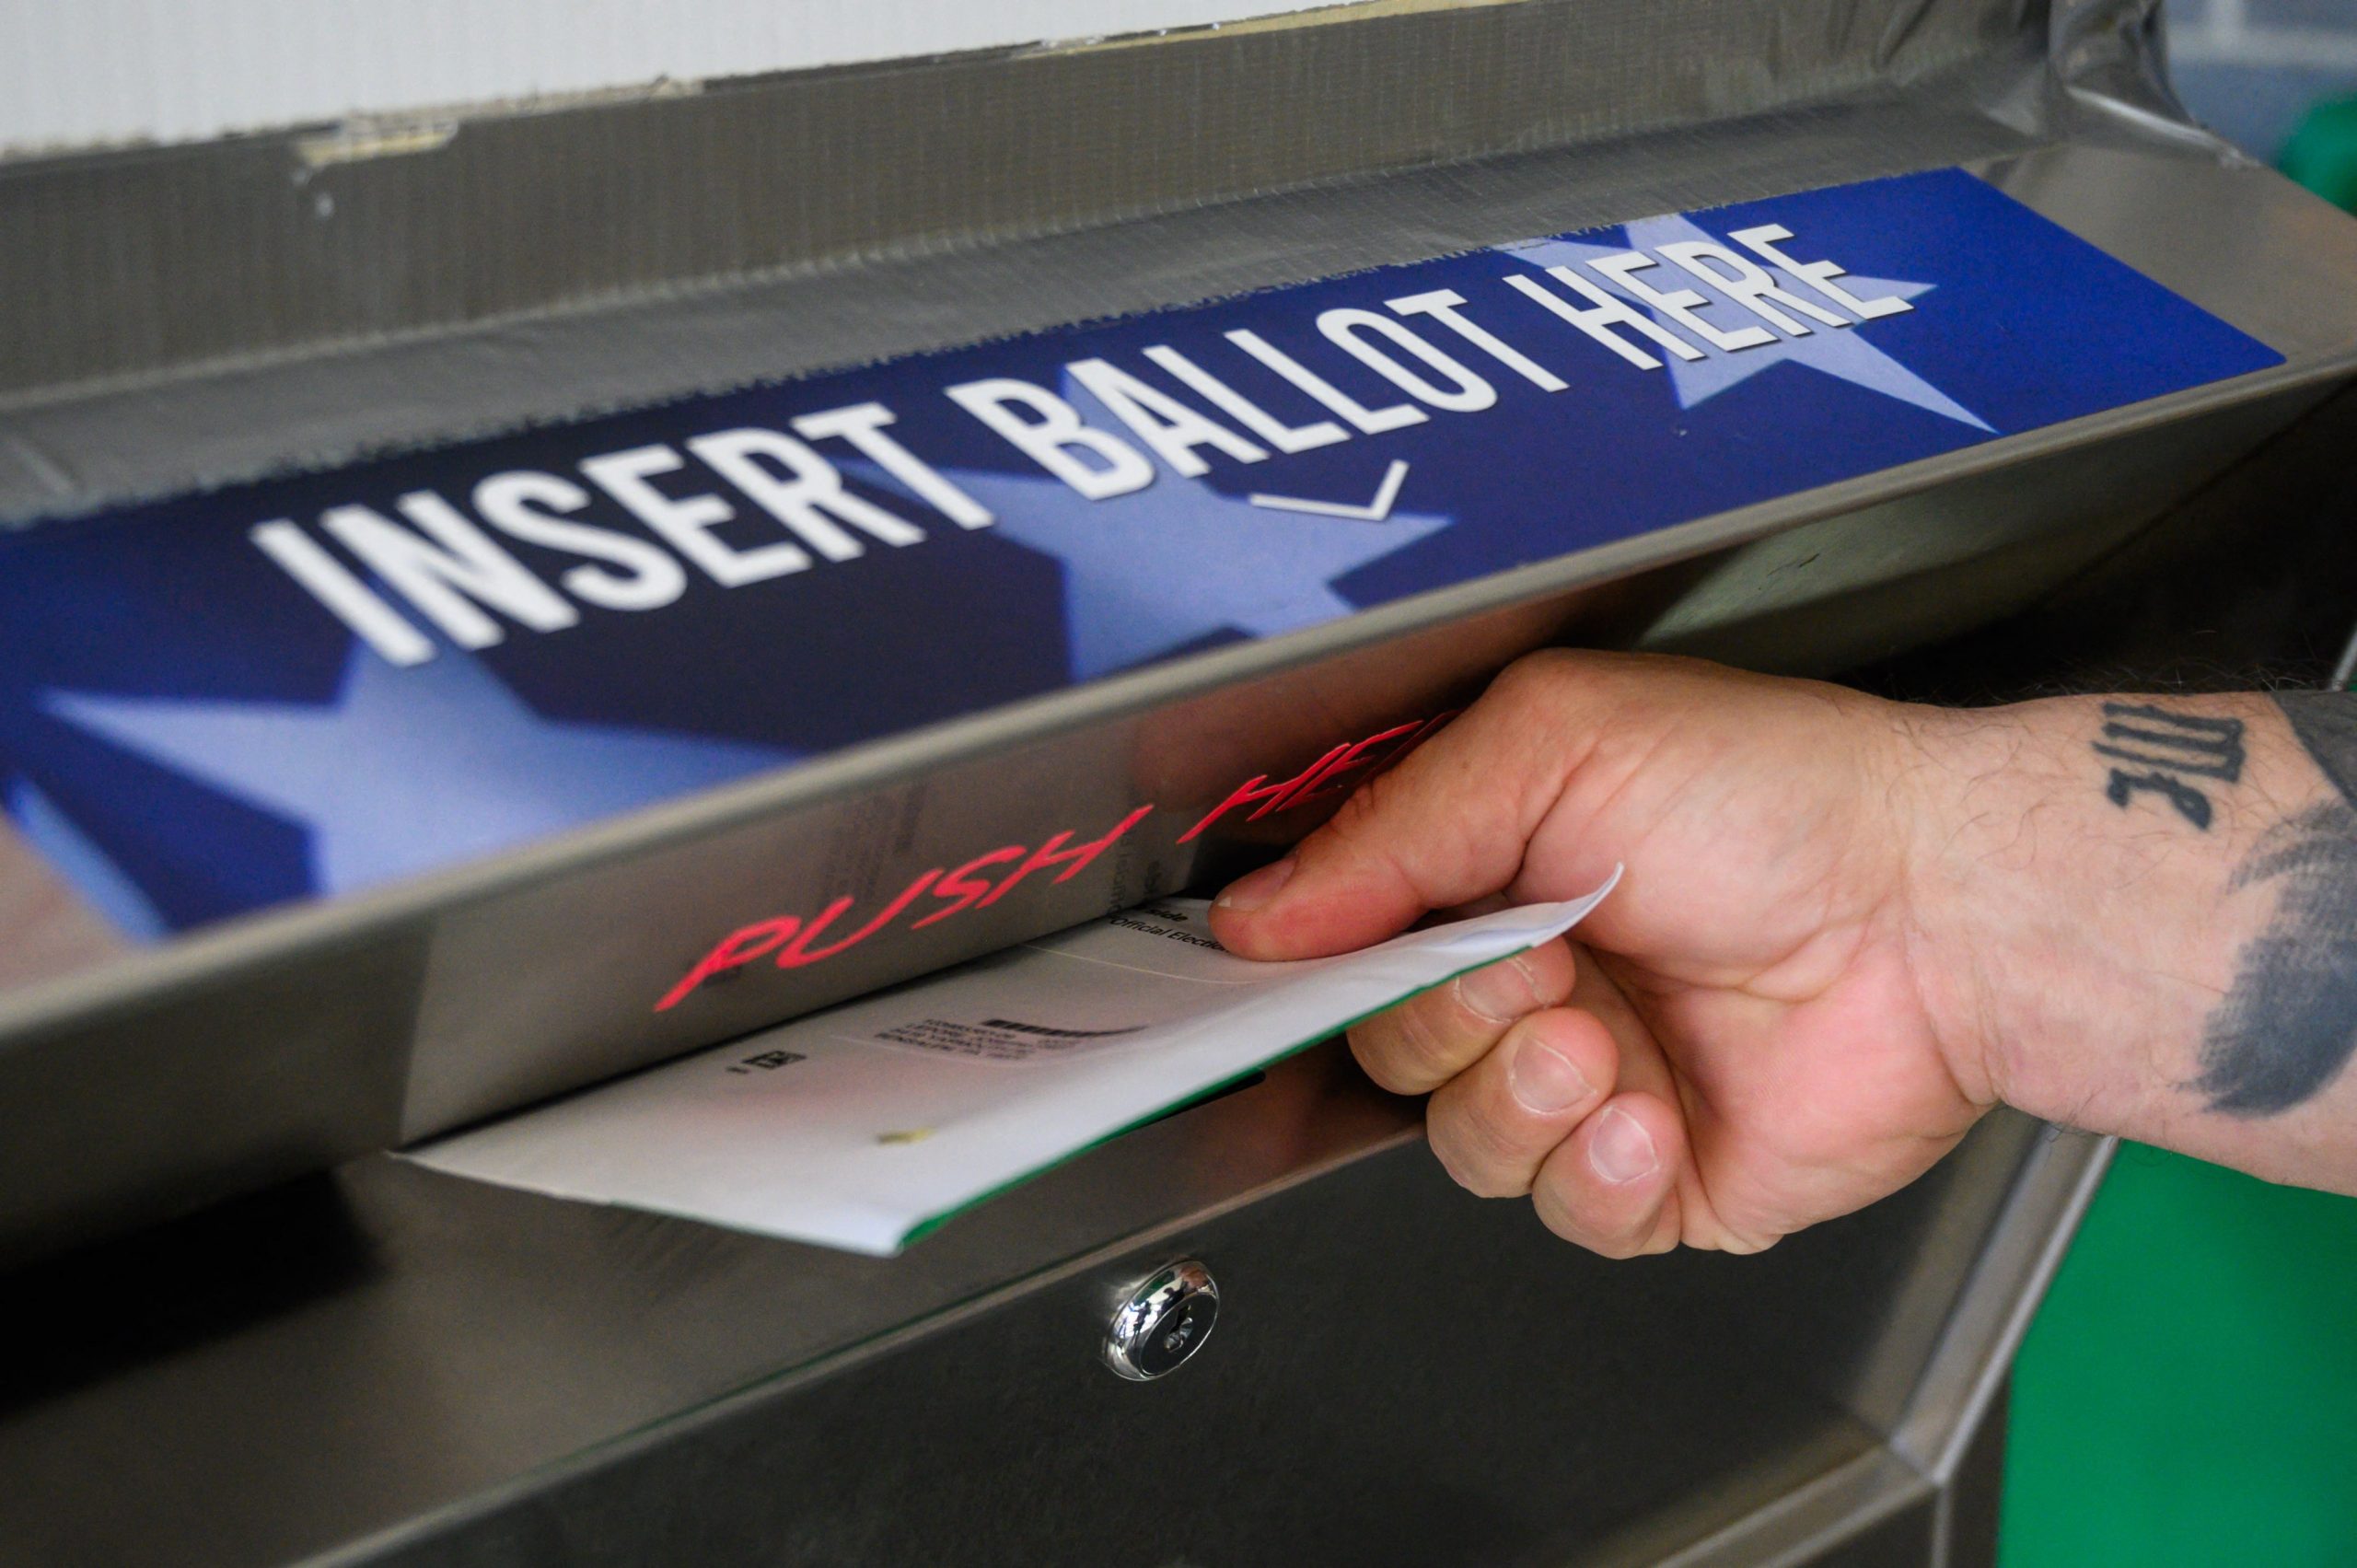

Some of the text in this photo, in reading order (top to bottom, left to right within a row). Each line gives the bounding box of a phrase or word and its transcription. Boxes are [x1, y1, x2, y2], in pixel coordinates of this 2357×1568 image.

[249, 223, 1915, 668] INSERT BALLOT HERE
[653, 803, 1155, 1013] PUSH
[1109, 917, 1231, 954] Official Electio
